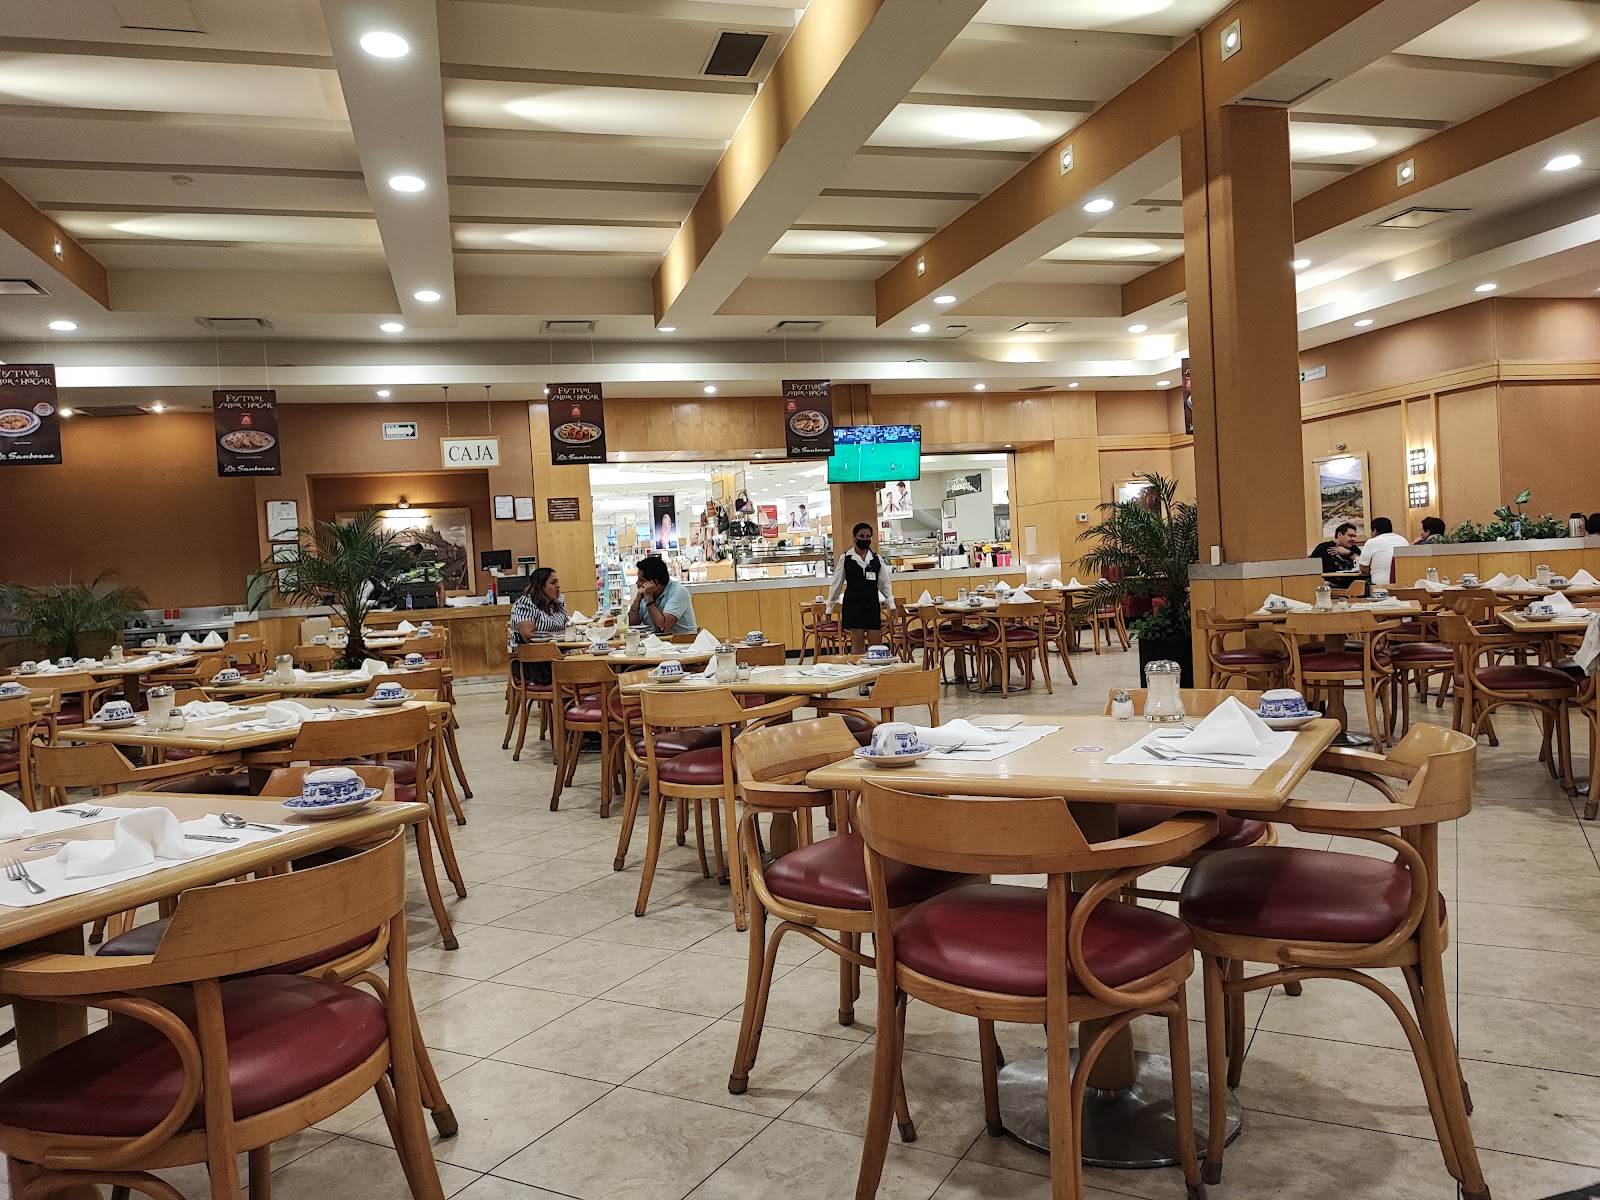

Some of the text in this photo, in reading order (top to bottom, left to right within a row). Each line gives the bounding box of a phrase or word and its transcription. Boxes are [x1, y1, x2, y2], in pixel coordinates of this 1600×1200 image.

[0, 369, 41, 378] ESTIVAL
[226, 394, 264, 402] FESTIVAL
[8, 452, 56, 460] Sanborns
[448, 445, 494, 462] CAJA
